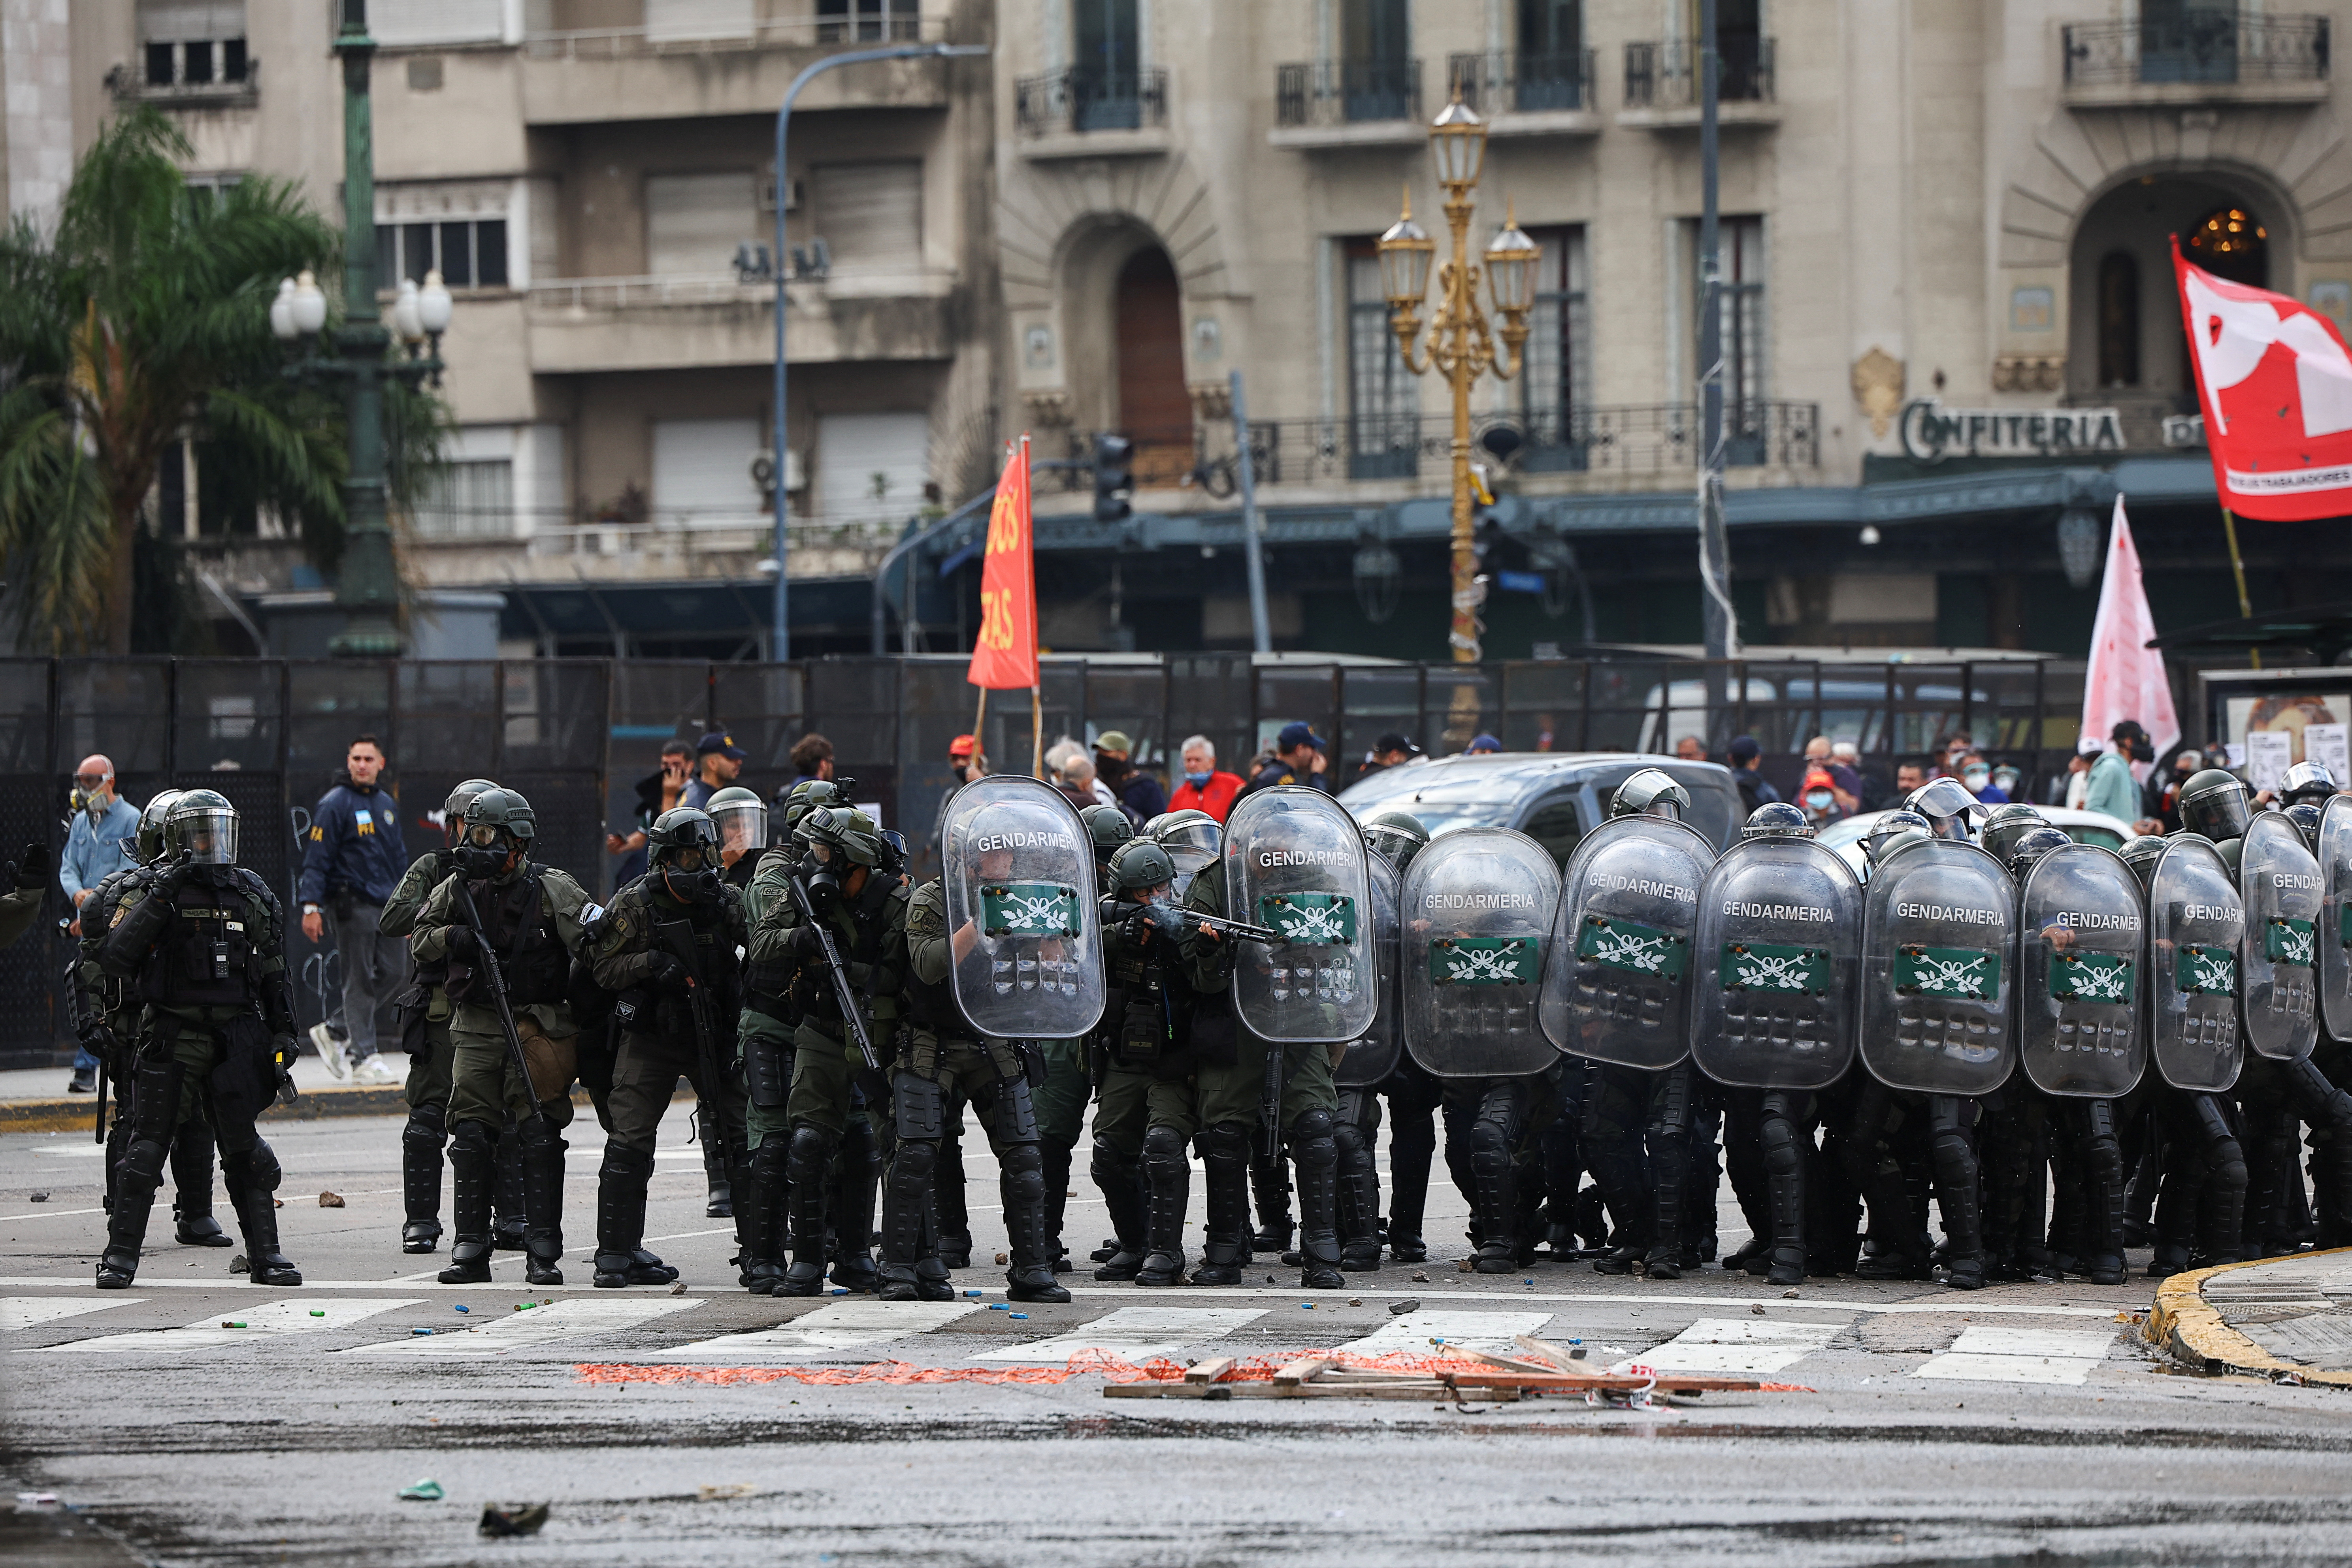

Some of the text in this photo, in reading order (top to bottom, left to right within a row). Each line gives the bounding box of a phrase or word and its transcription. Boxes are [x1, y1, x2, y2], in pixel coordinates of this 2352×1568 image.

[978, 831, 1079, 852] GENDARMERIA
[1259, 850, 1357, 869] GENDARMERIA
[1589, 872, 1698, 905] GENDARMERIA
[1426, 894, 1536, 909] GENDARMERIA
[1723, 901, 1834, 923] GENDARMERIA
[1897, 902, 2005, 927] GENDARMERIA
[620, 1003, 633, 1012] CONDOR
